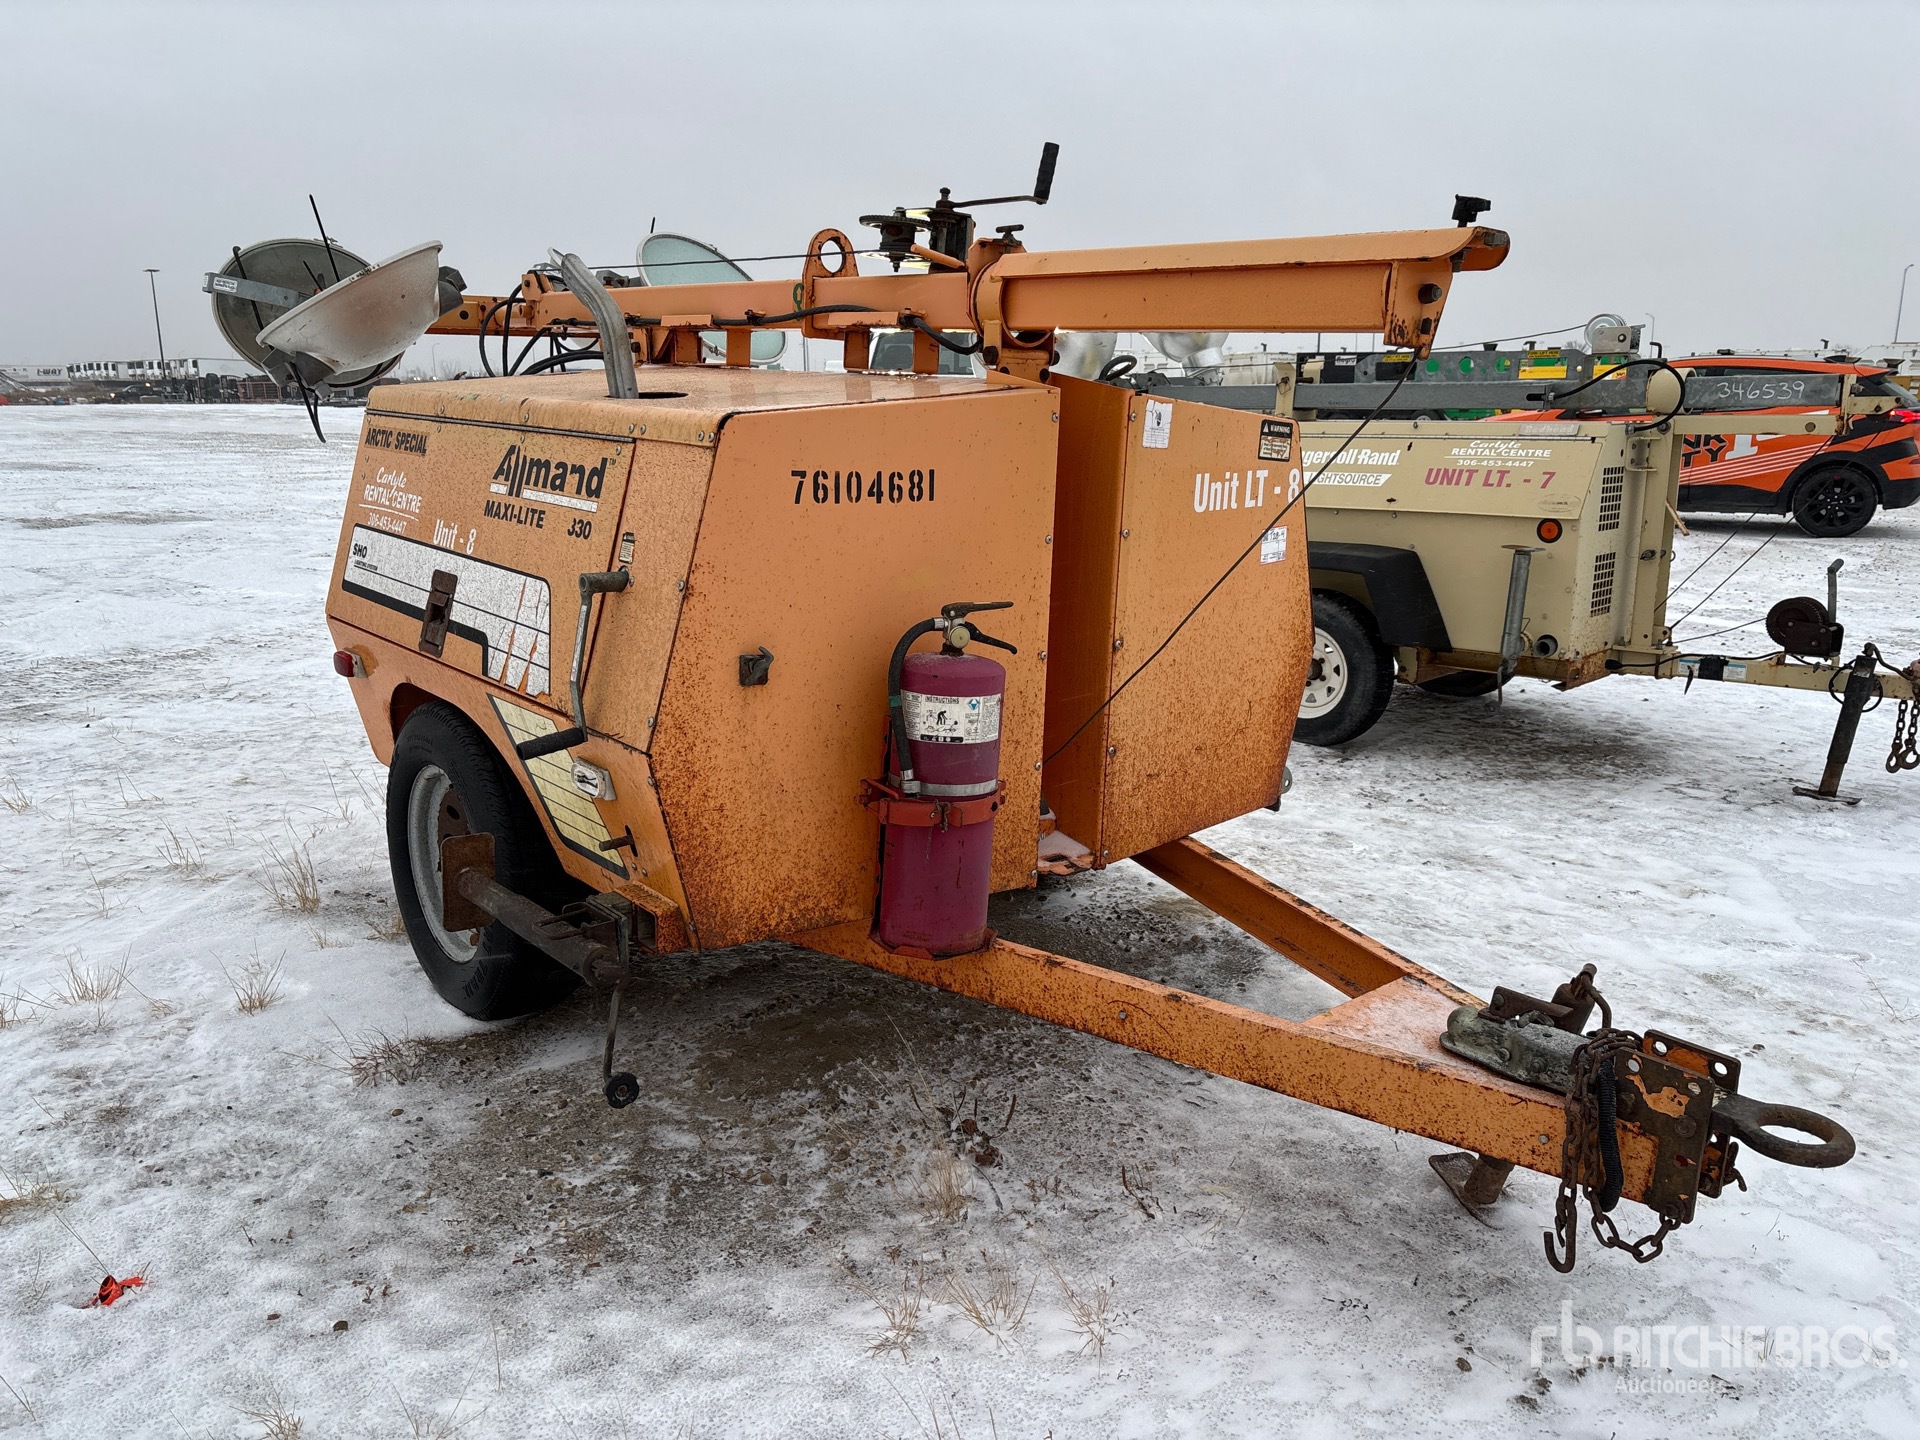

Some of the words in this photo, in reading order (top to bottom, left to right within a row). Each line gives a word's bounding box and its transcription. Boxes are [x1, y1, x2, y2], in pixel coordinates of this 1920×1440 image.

[1717, 381, 1804, 400] 346539
[365, 428, 392, 449] ARCTIC
[395, 431, 427, 456] SPECIAL
[1451, 447, 1497, 456] RENTAL
[1501, 448, 1552, 457] CENTRE
[1470, 440, 1521, 454] Carlyle
[493, 444, 608, 499] Allmand
[1457, 459, 1534, 468] 306-453-4447
[376, 466, 407, 498] Carlyle
[791, 469, 935, 505] 76104681
[1194, 471, 1239, 513] Unit
[1245, 469, 1269, 508] LT
[1287, 468, 1300, 504] 8
[1424, 467, 1479, 487] UNIT
[1482, 469, 1512, 488] LT.
[1540, 471, 1557, 489] 7
[363, 484, 389, 506] RENTAL
[391, 490, 423, 513] CENTRE
[483, 499, 546, 529] MAXI-LITE
[433, 519, 458, 551] Unit
[466, 528, 477, 555] 8
[567, 517, 593, 540] 330
[353, 543, 368, 558] SHO
